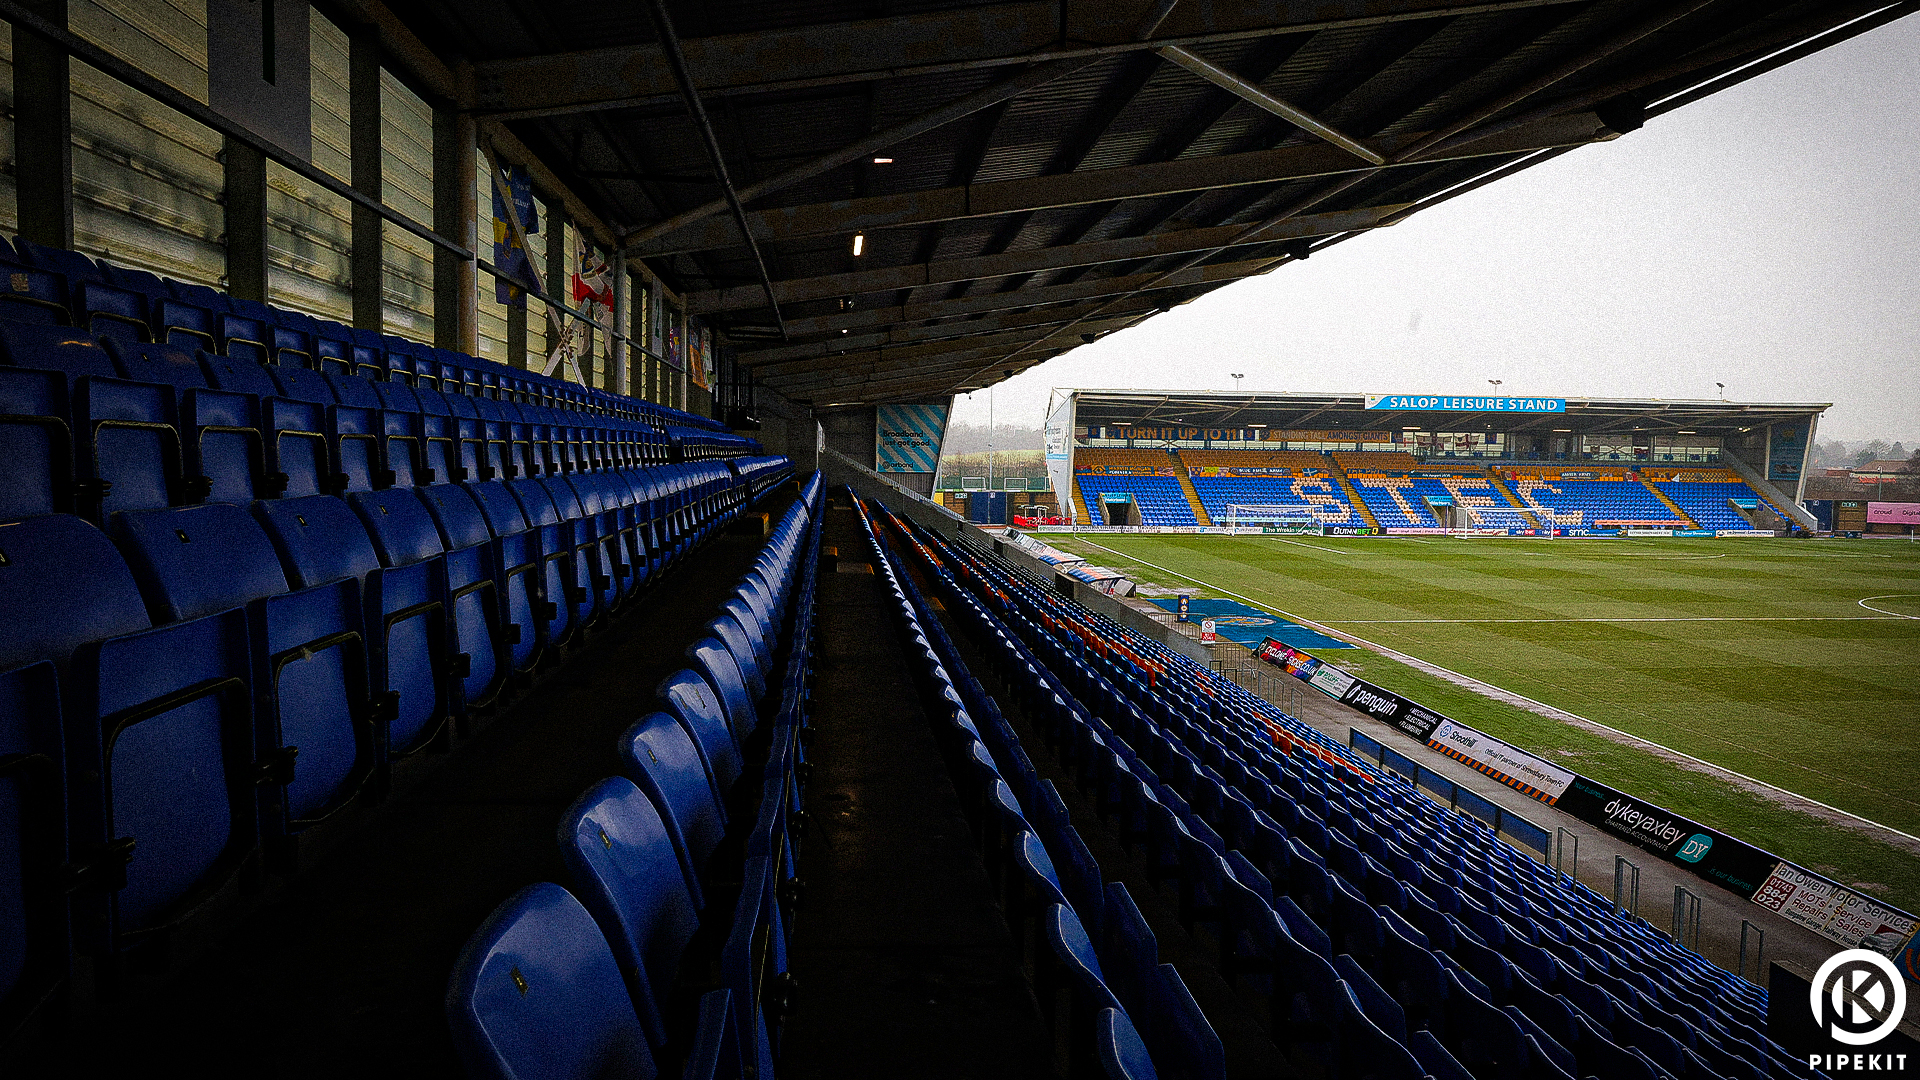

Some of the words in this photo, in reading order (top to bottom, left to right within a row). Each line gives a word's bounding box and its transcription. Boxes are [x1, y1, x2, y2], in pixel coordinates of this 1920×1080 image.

[1390, 397, 1439, 409] SALOP
[1443, 398, 1504, 410] LEISURE
[1508, 399, 1558, 411] STAND
[883, 430, 924, 438] Broadband
[1119, 427, 1157, 440] TURN
[1161, 428, 1175, 440] IT
[1178, 428, 1198, 440] UP
[1203, 429, 1222, 441] TO
[1224, 429, 1237, 441] 11
[1273, 431, 1311, 440] STANDING
[1327, 431, 1360, 440] AMONGST
[1361, 432, 1389, 441] GIANTS
[883, 439, 896, 447] just
[897, 440, 910, 448] got
[911, 439, 932, 449] good.
[1333, 527, 1371, 535] QUINNBET
[1352, 688, 1398, 716] penguin
[1450, 730, 1478, 749] Shoothill
[1485, 748, 1498, 758] Official
[1501, 756, 1518, 768] partner
[1521, 764, 1546, 780] Shrewsbury
[1545, 775, 1557, 785] Town
[1556, 780, 1564, 788] FC
[1604, 799, 1686, 846] dykeyaxley
[1605, 818, 1631, 834] CHARTERED
[1631, 830, 1669, 851] ACCOUNTANTS
[1682, 840, 1708, 858] DY
[1716, 869, 1727, 880] our
[1726, 873, 1754, 891] business
[1769, 878, 1793, 893] 01743
[1757, 893, 1781, 909] 023
[1763, 885, 1787, 901] 884
[1774, 863, 1794, 880] Ian
[1795, 873, 1827, 894] Owen
[1826, 887, 1864, 910] Motor
[1863, 901, 1918, 933] Services
[1792, 898, 1828, 920] Repairs
[1836, 918, 1866, 938] Sales
[1798, 890, 1827, 907] MOTs
[1834, 906, 1872, 929] Service
